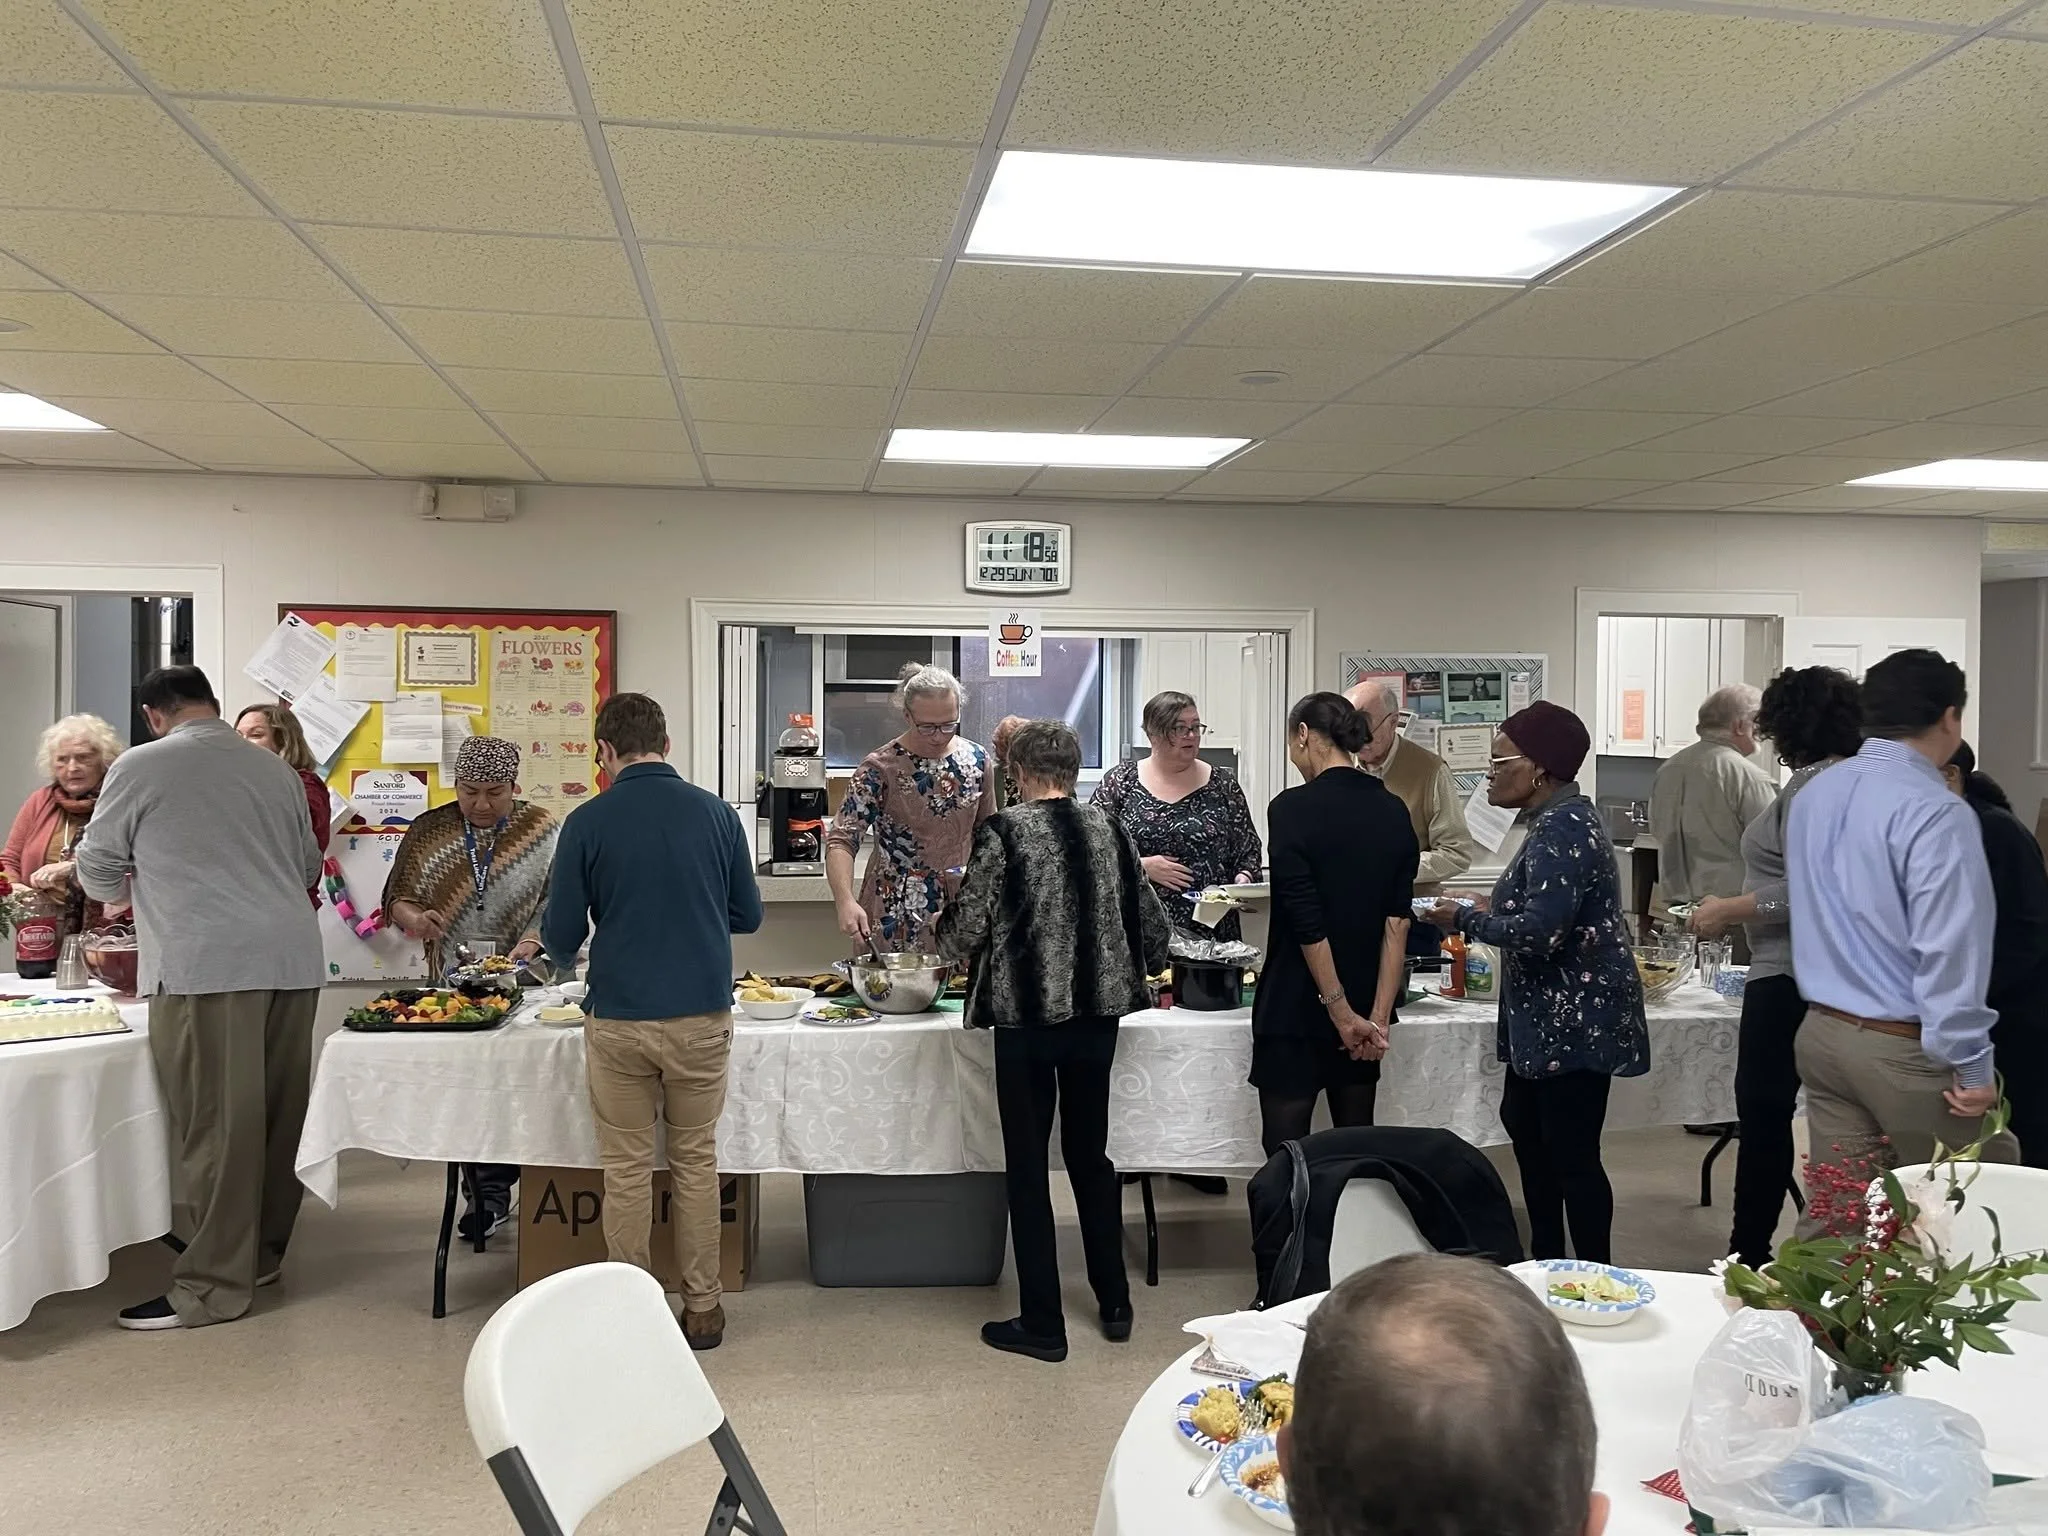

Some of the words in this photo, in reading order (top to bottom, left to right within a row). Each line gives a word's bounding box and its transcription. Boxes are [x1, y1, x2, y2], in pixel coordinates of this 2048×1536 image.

[987, 532, 1044, 562] 11:18
[991, 568, 1005, 581] 29
[1007, 568, 1032, 581] SUN
[502, 640, 582, 656] FLOWERS
[997, 649, 1019, 667] Coffee
[1020, 650, 1037, 667] Hour
